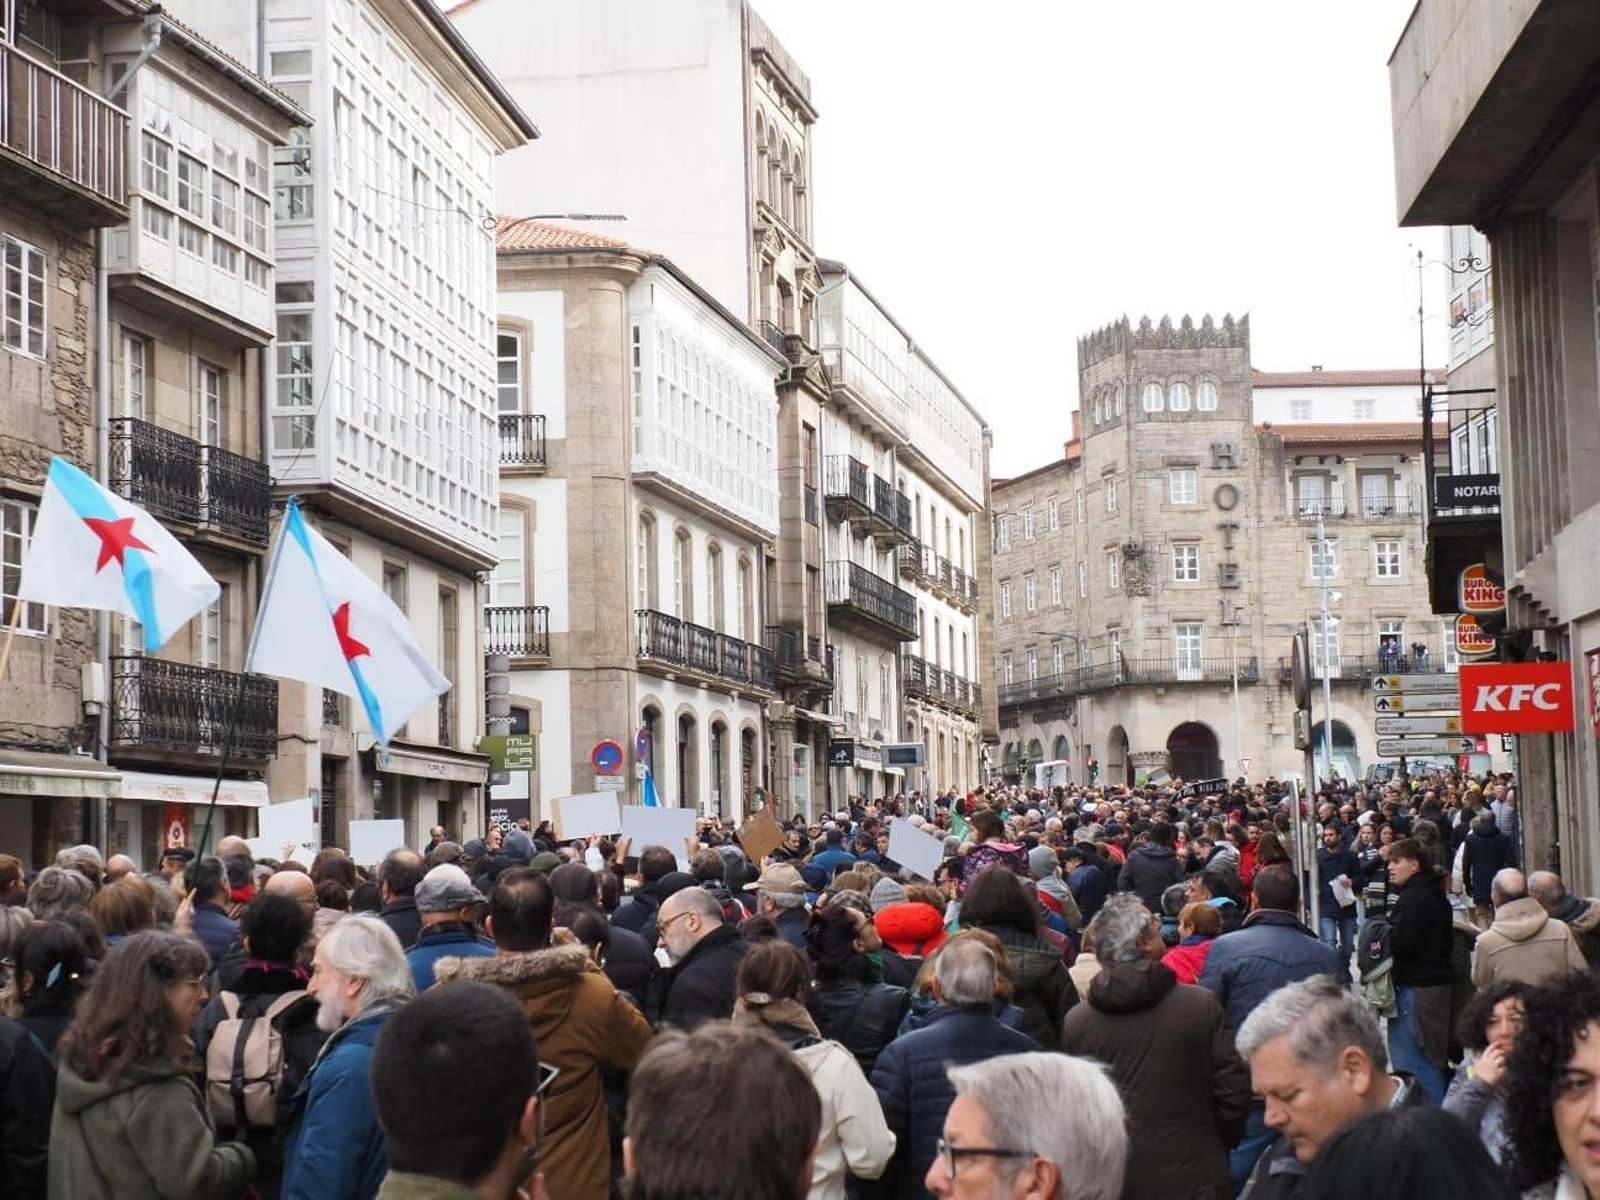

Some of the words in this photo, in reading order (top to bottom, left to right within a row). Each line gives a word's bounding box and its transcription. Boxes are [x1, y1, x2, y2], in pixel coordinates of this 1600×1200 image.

[1210, 443, 1240, 627] HOTEL
[1463, 579, 1497, 588] BURG
[1464, 589, 1505, 601] KING
[1472, 682, 1561, 711] KFC
